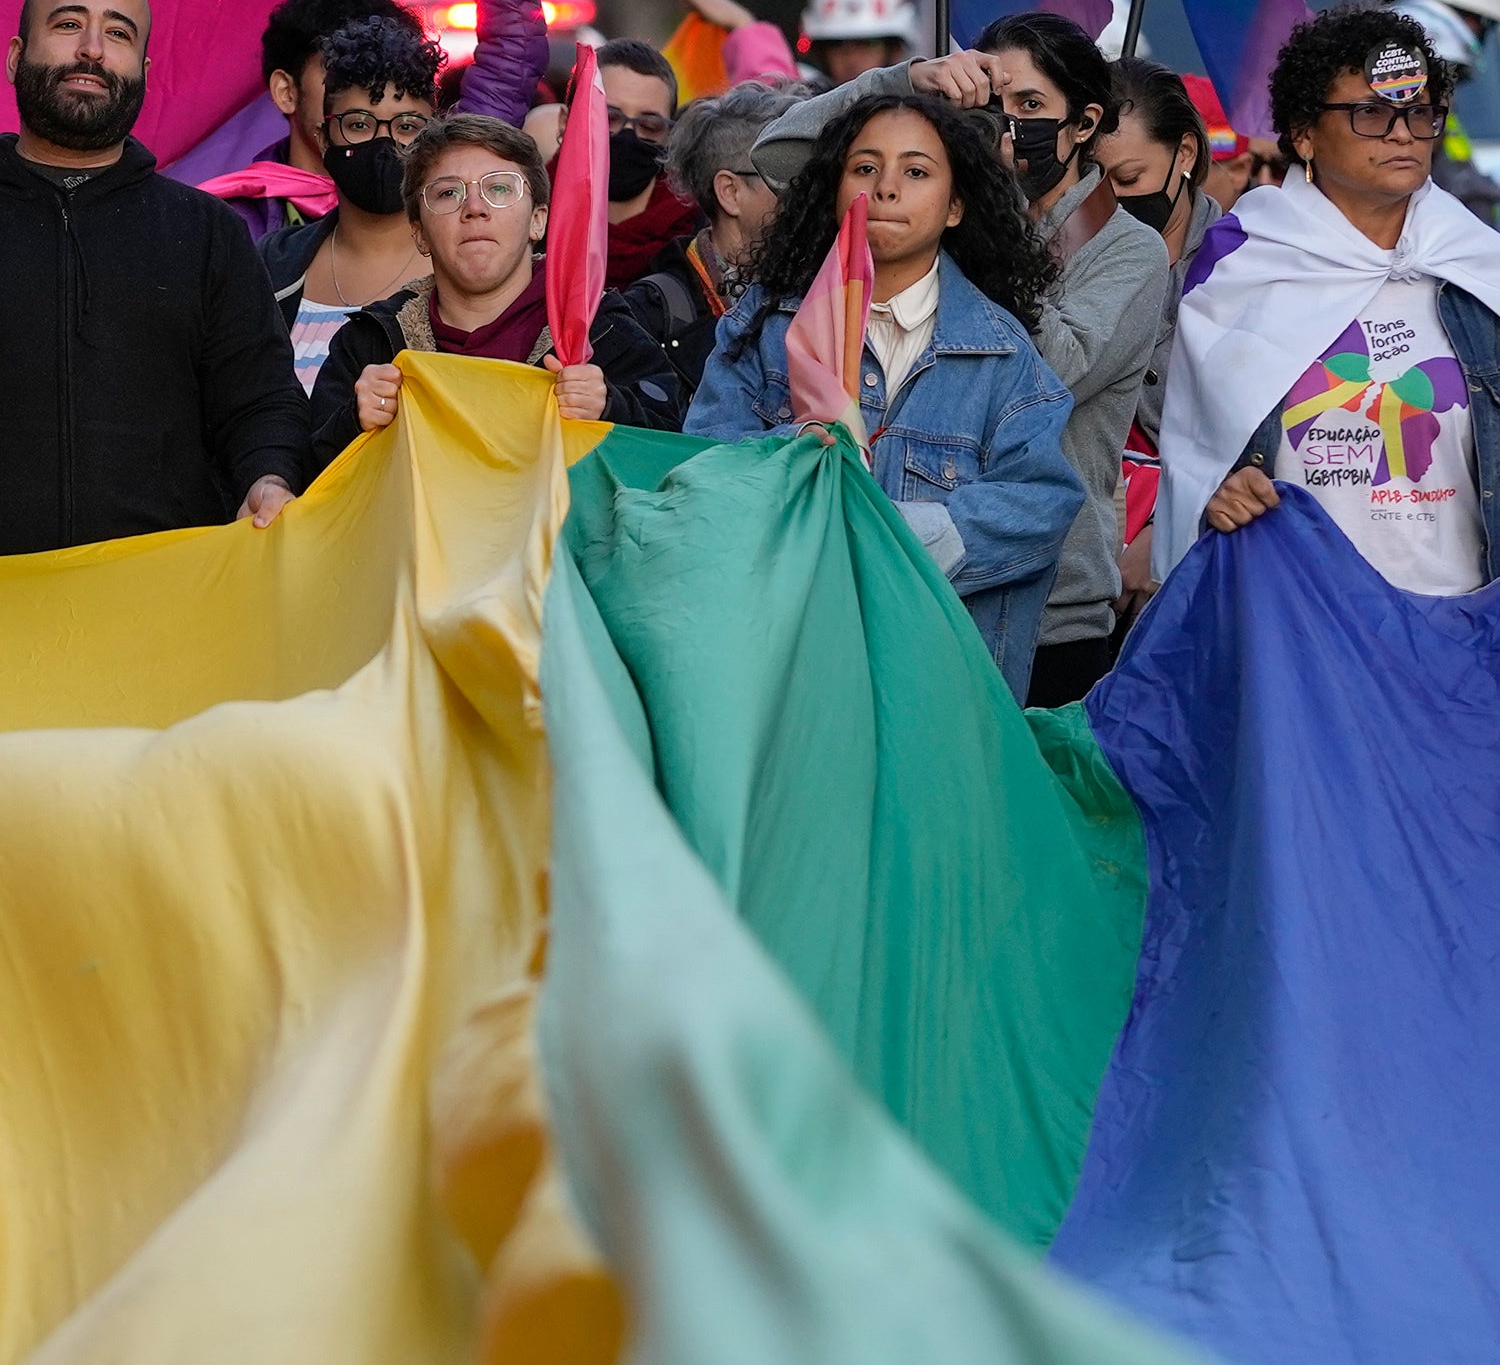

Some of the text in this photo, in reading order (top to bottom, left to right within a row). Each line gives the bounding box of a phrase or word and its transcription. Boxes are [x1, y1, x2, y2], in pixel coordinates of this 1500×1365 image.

[1371, 60, 1421, 75] BOLSONARO
[1376, 54, 1412, 67] CONTRA
[1363, 319, 1406, 334] Trans
[1371, 329, 1416, 349] forma
[1373, 343, 1411, 362] ação
[1308, 425, 1381, 444] EDUCAÇÃO
[1304, 445, 1374, 465] SEM
[1305, 468, 1374, 487] LGBTFOBIA
[1371, 512, 1402, 521] CNTE
